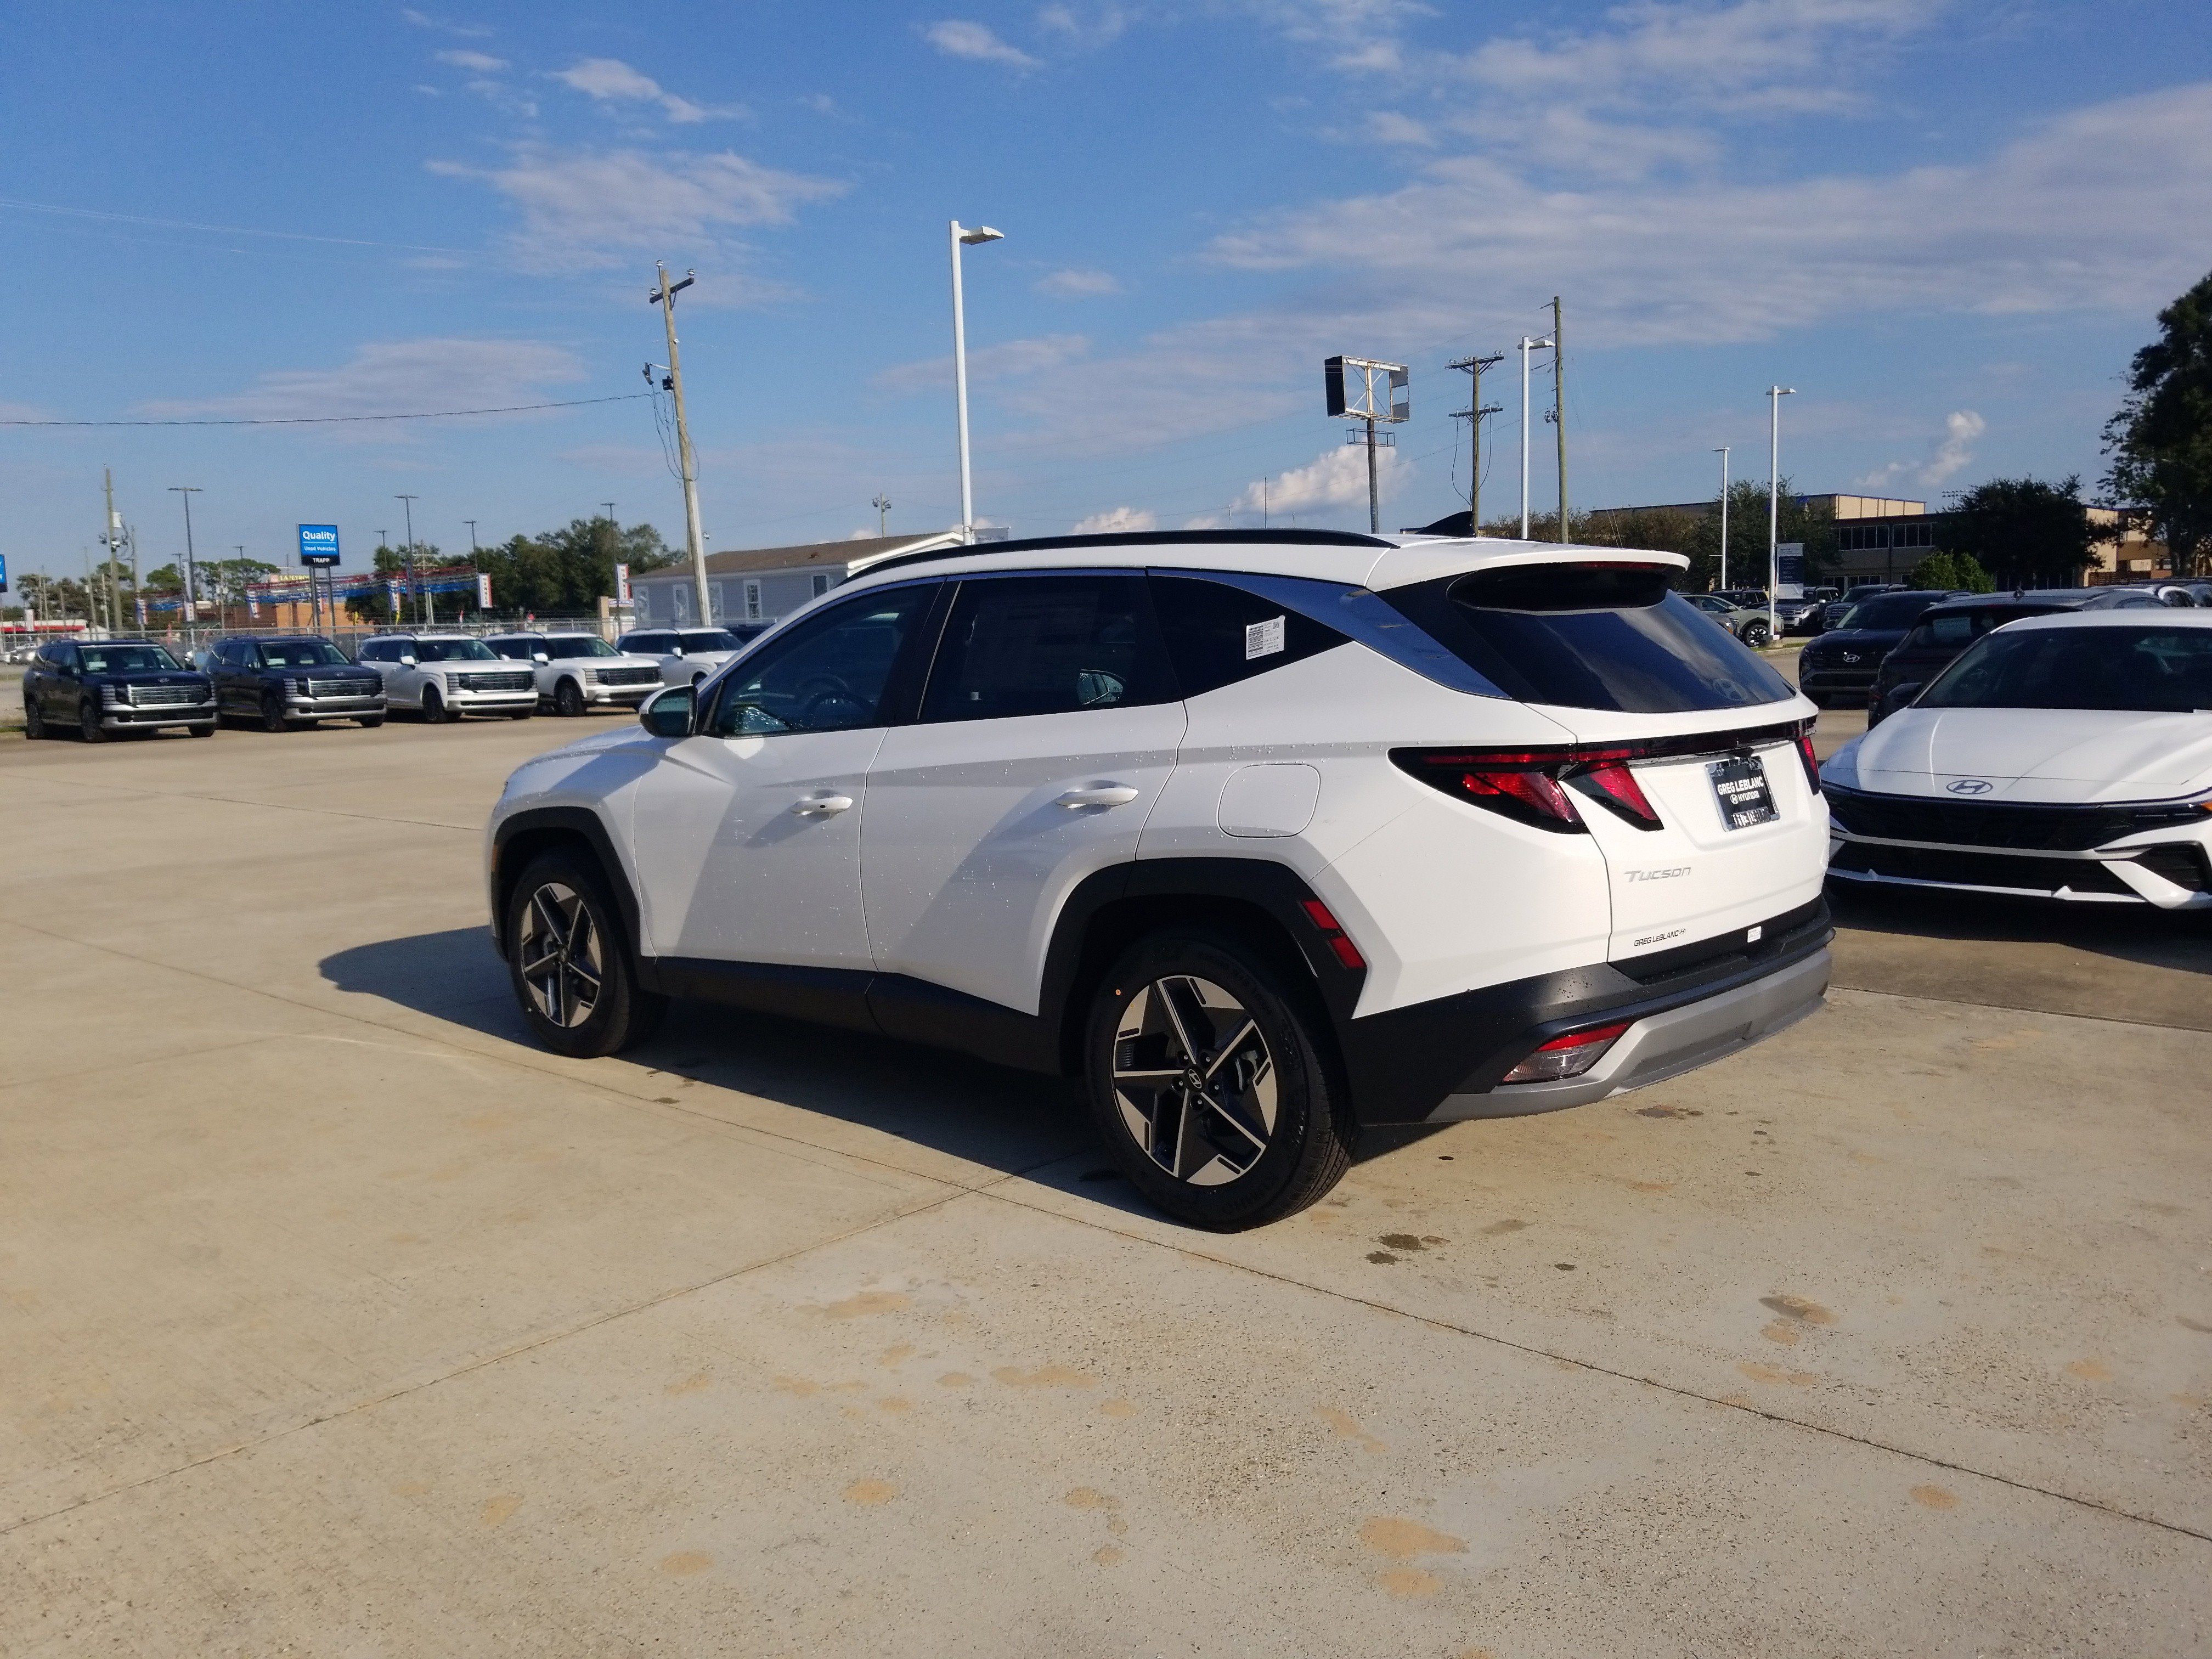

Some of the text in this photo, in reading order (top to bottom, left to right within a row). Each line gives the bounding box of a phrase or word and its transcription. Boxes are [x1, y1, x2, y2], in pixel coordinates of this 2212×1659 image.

[302, 531, 336, 541] Quality
[1717, 776, 1764, 795] GREG LEBLANC
[1738, 790, 1760, 802] HYUNDAI
[1634, 936, 1652, 947] GREG
